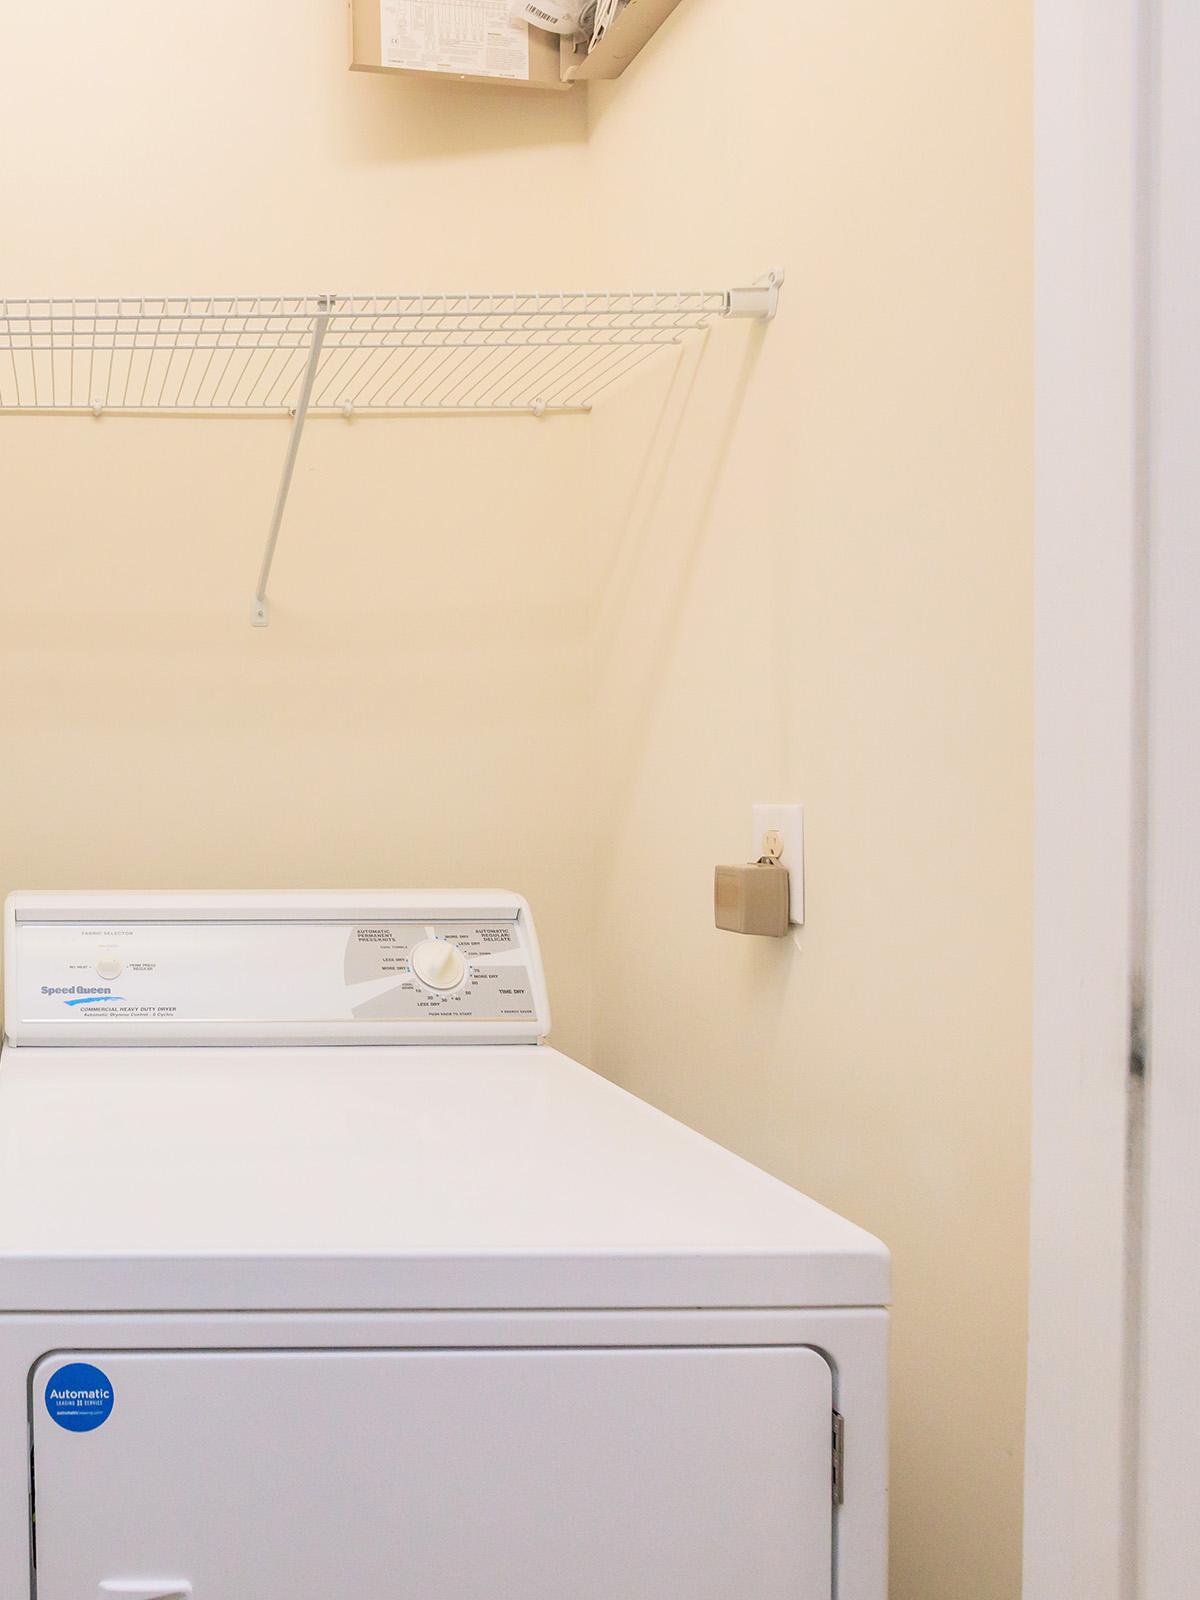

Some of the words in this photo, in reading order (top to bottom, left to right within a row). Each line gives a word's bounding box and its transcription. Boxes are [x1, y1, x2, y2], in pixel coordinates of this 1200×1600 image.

[41, 985, 76, 996] Speed
[76, 985, 112, 995] Queen
[49, 1388, 110, 1399] Automatic
